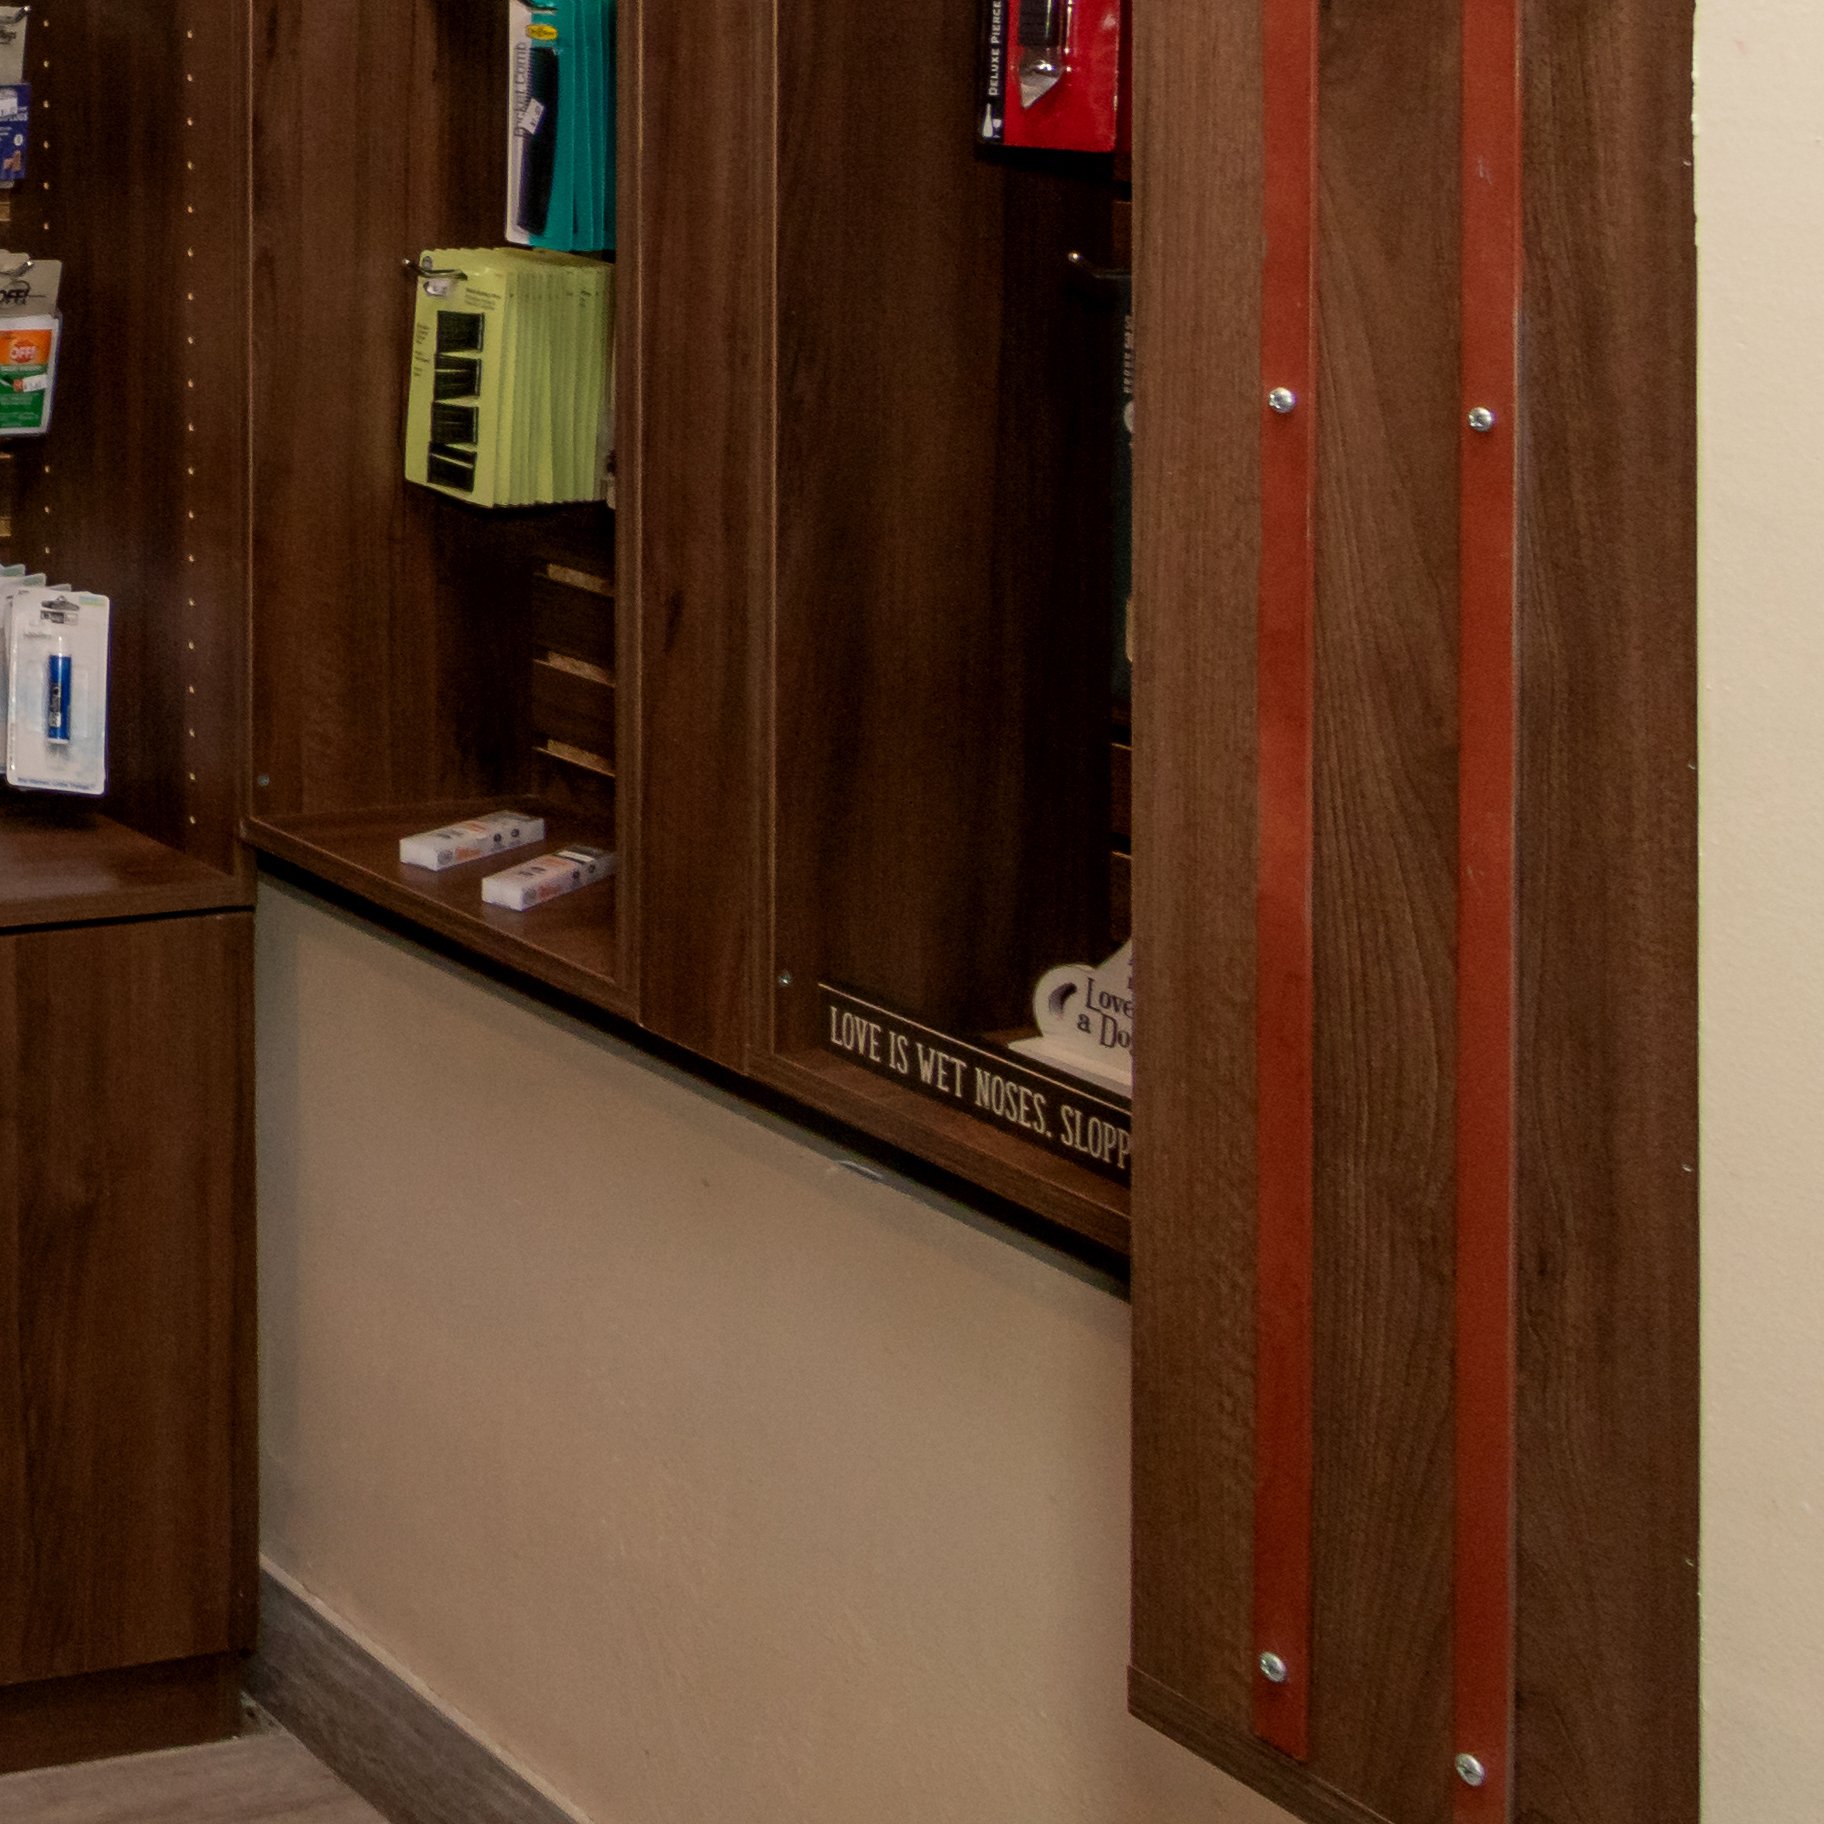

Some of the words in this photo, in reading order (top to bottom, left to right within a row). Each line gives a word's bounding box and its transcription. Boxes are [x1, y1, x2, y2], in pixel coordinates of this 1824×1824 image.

[990, 0, 1001, 47] PIERCE
[513, 42, 528, 78] Comb
[987, 47, 999, 96] DELUXE
[513, 81, 528, 138] Pocket
[10, 345, 37, 359] OFF!
[1085, 975, 1133, 1019] Love
[1076, 1012, 1092, 1035] a
[828, 1005, 881, 1064] LOVE
[888, 1029, 909, 1076] IS
[916, 1041, 968, 1099] WET
[974, 1066, 1053, 1139] NOSES.
